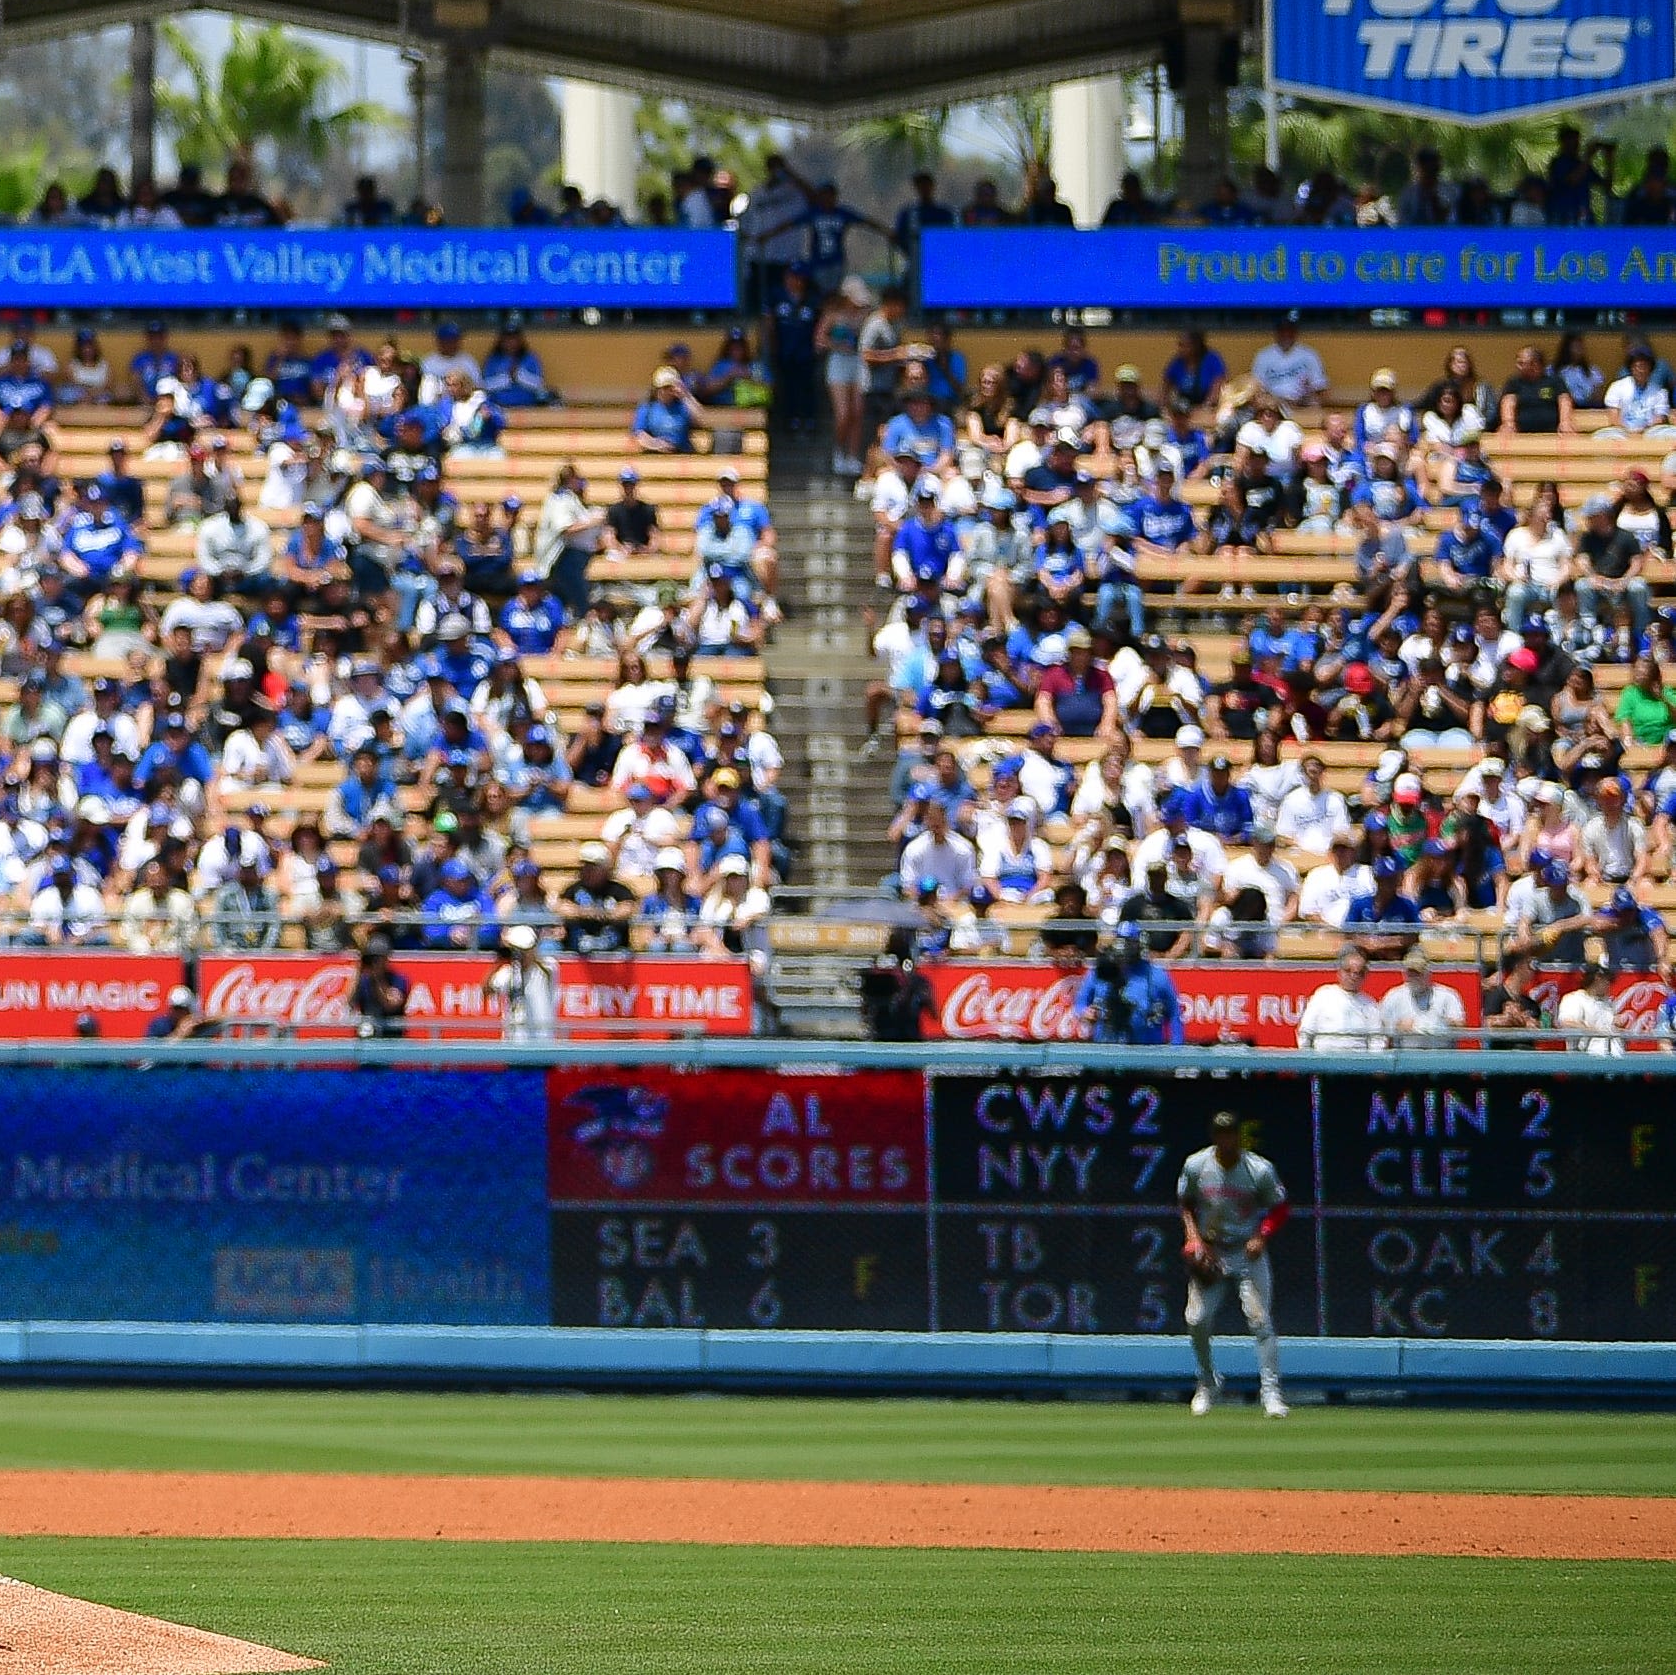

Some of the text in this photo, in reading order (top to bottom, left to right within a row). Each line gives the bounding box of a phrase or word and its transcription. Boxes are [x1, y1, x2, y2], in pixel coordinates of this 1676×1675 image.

[1358, 16, 1632, 80] TIRES
[104, 243, 213, 284] West
[223, 243, 351, 292] Valley
[362, 243, 530, 284] Medical
[539, 243, 685, 285] Center
[1157, 243, 1287, 283] Proud
[1300, 248, 1344, 282] to
[1355, 252, 1445, 283] care
[1460, 243, 1521, 282] for
[1534, 244, 1608, 283] Los
[47, 981, 160, 1011] MAGIC
[404, 983, 436, 1014] A
[646, 984, 742, 1019] TIME
[1177, 993, 1251, 1025] OME
[1257, 995, 1309, 1026] RU
[760, 1091, 834, 1138] AL
[975, 1083, 1163, 1136] CWS 2
[1368, 1090, 1552, 1138] MIN 2
[13, 1154, 216, 1202] Medical
[230, 1157, 407, 1204] Center
[684, 1143, 911, 1190] SCORES
[976, 1144, 1166, 1192] NYY 7
[1366, 1148, 1554, 1197] CLE 5
[596, 1221, 779, 1269] SEA 3
[977, 1223, 1165, 1273] TB 2
[1368, 1226, 1561, 1277] OAK 4
[597, 1280, 781, 1327] BAL 6
[977, 1283, 1167, 1332] TOR 5
[1369, 1289, 1560, 1336] KC 8
